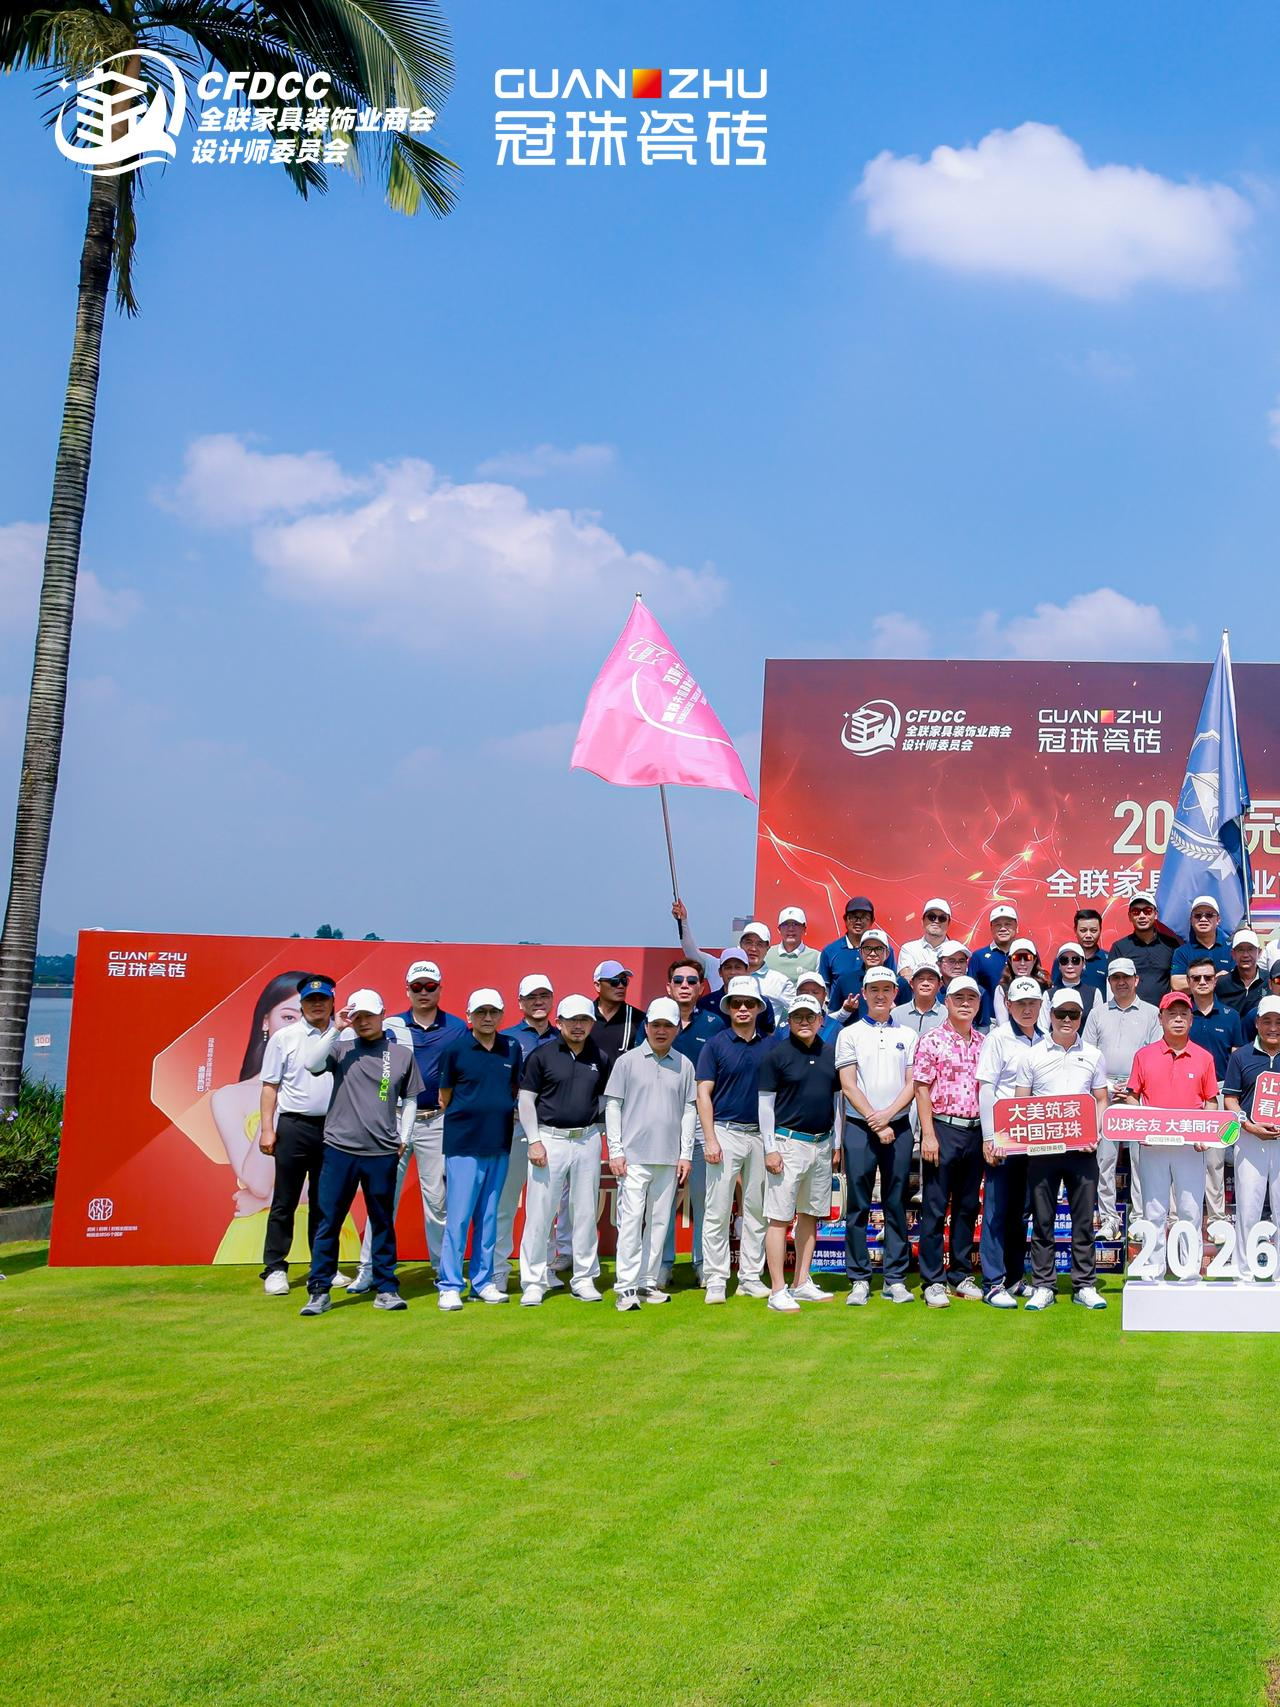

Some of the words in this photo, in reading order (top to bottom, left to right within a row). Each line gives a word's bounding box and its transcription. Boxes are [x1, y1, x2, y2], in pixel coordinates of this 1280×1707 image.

[905, 709, 967, 723] CFDCC
[1038, 709, 1099, 724] GUAN
[1117, 709, 1162, 724] ZHU
[904, 724, 1013, 739] 全联家具装饰业商会
[901, 738, 974, 752] 设计师委员会
[1038, 727, 1162, 754] 冠珠瓷砖
[108, 950, 148, 962] GUAN
[158, 951, 188, 962] ZHU
[107, 961, 187, 978] 冠珠瓷砖
[1008, 1099, 1082, 1122] 大美筑家
[1009, 1120, 1083, 1143] 中国冠珠
[1107, 1117, 1162, 1133] 以球会友
[1165, 1118, 1220, 1134] 大美同行
